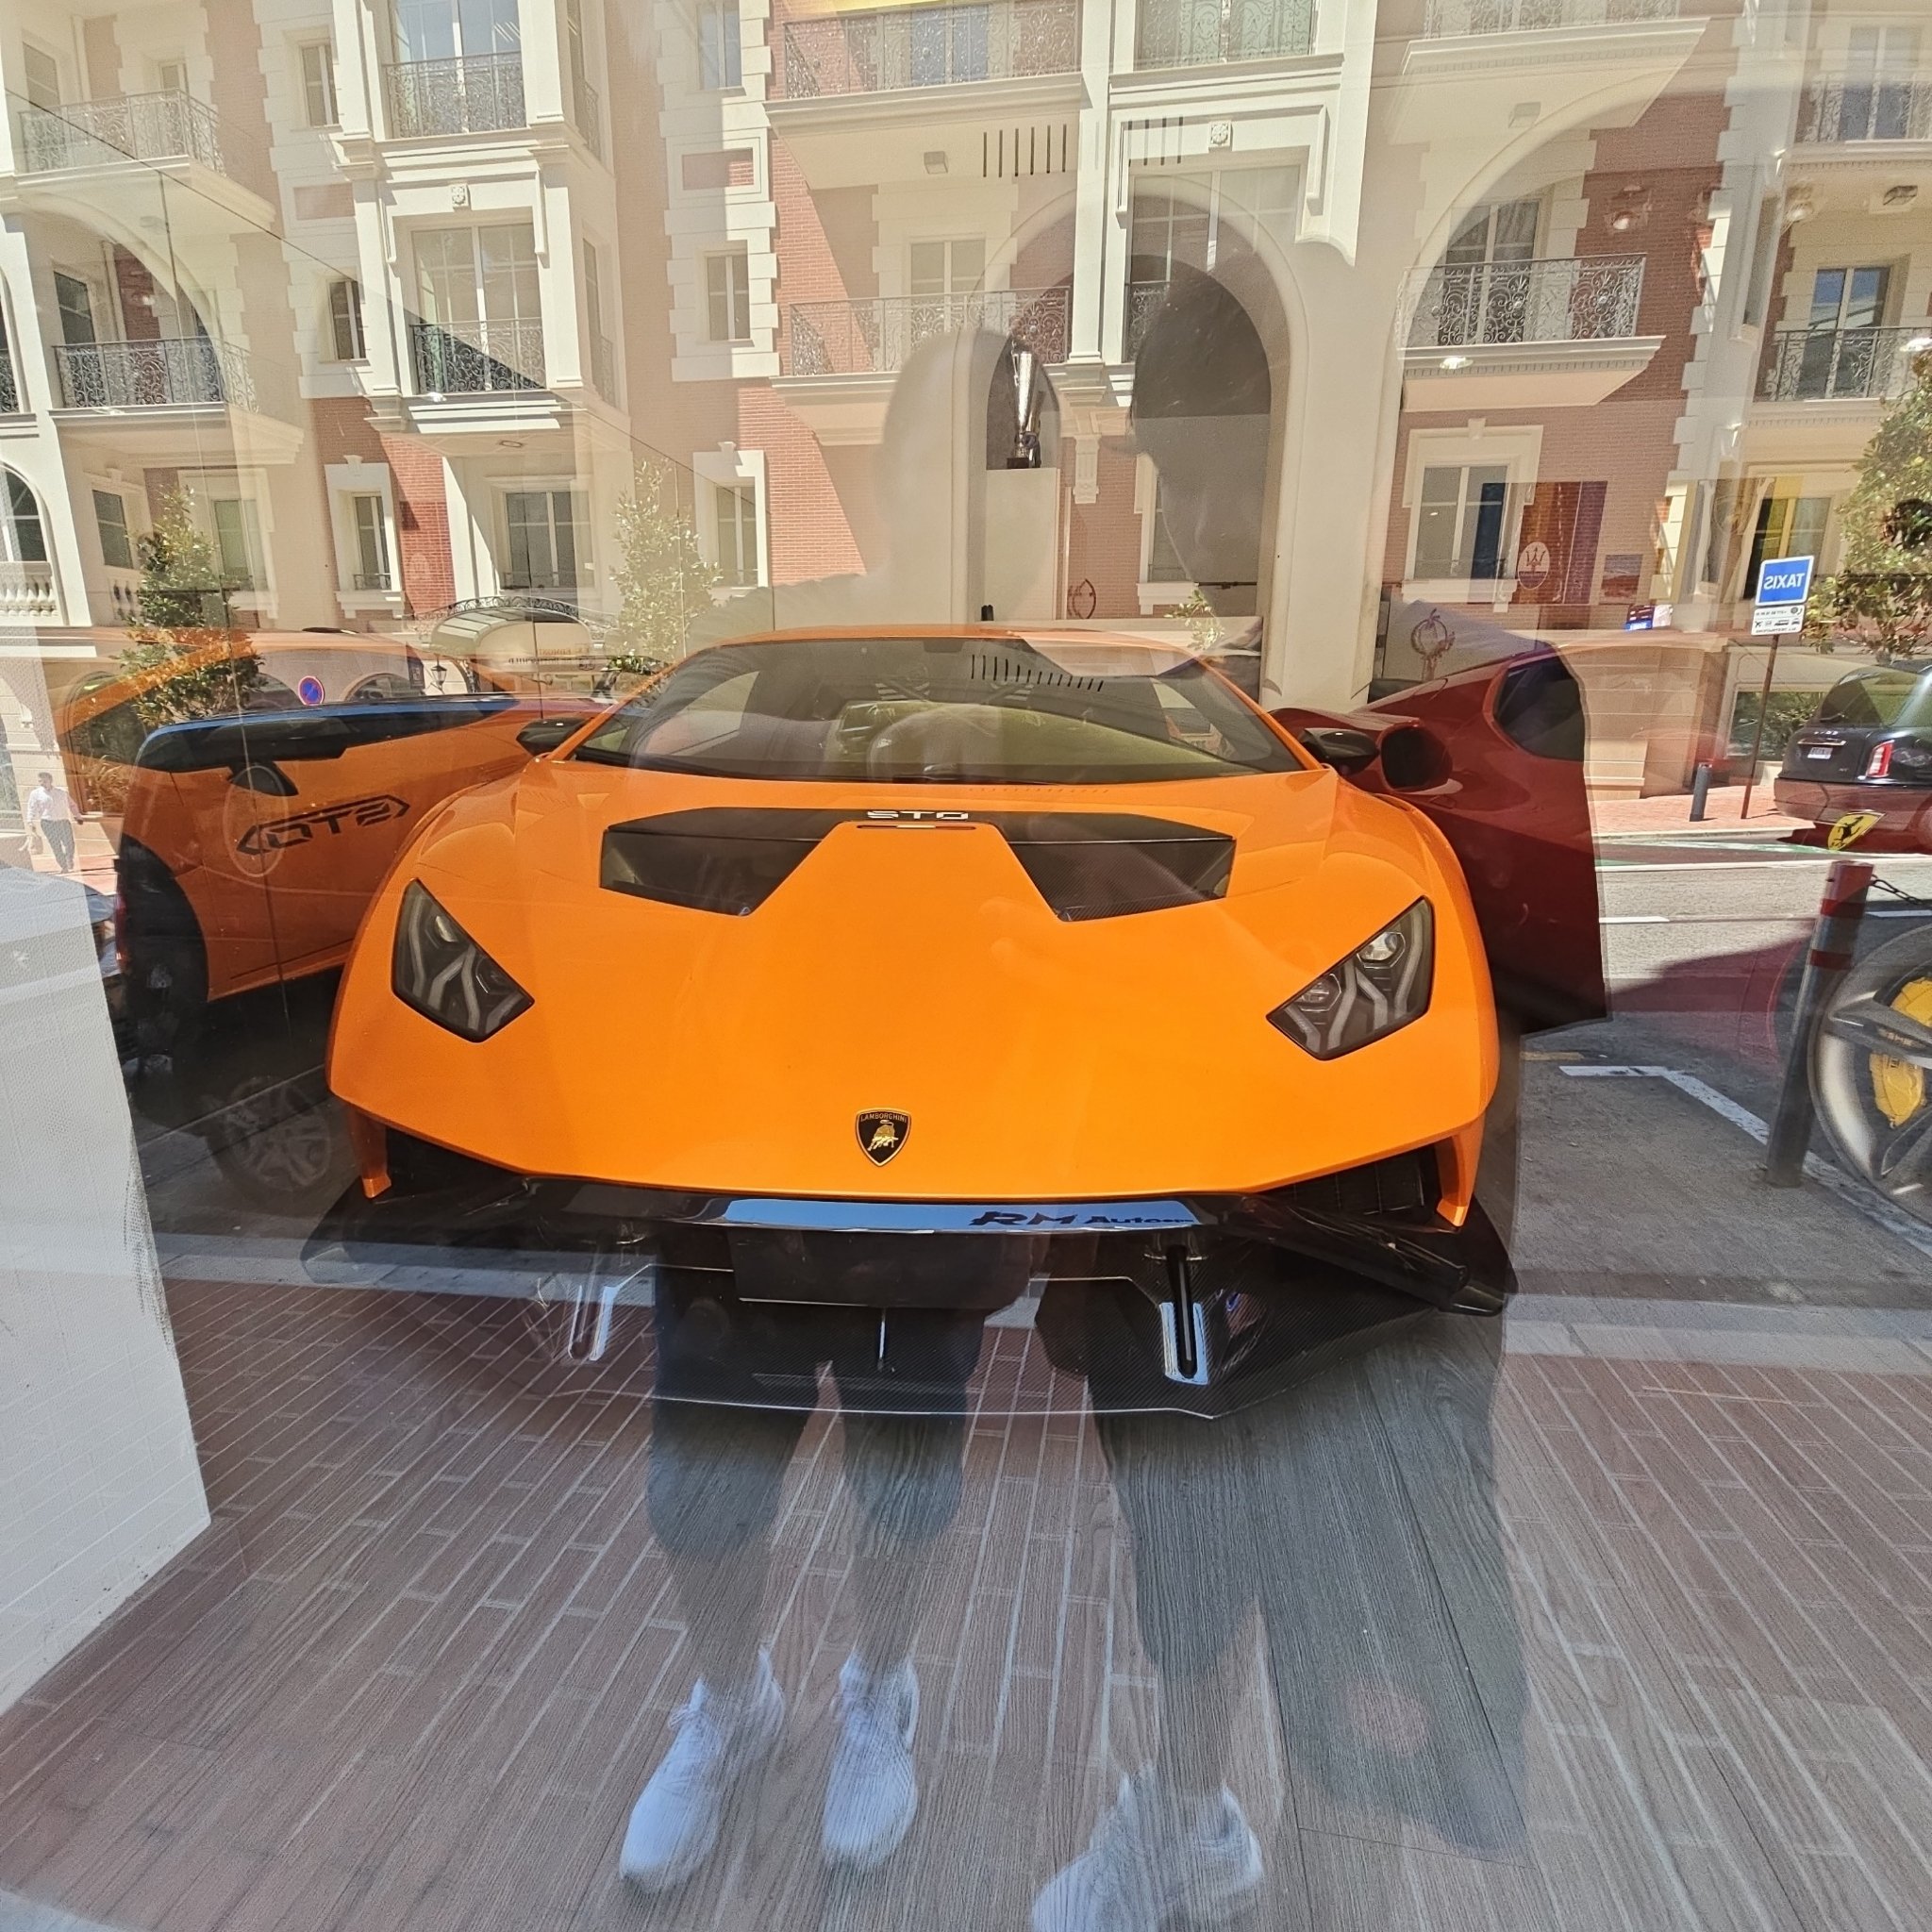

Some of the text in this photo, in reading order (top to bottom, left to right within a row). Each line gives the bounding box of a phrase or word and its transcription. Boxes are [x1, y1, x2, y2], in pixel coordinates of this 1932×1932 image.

[867, 810, 969, 820] STO
[860, 1113, 908, 1124] LAMBORGHINI
[969, 1211, 1077, 1225] RM
